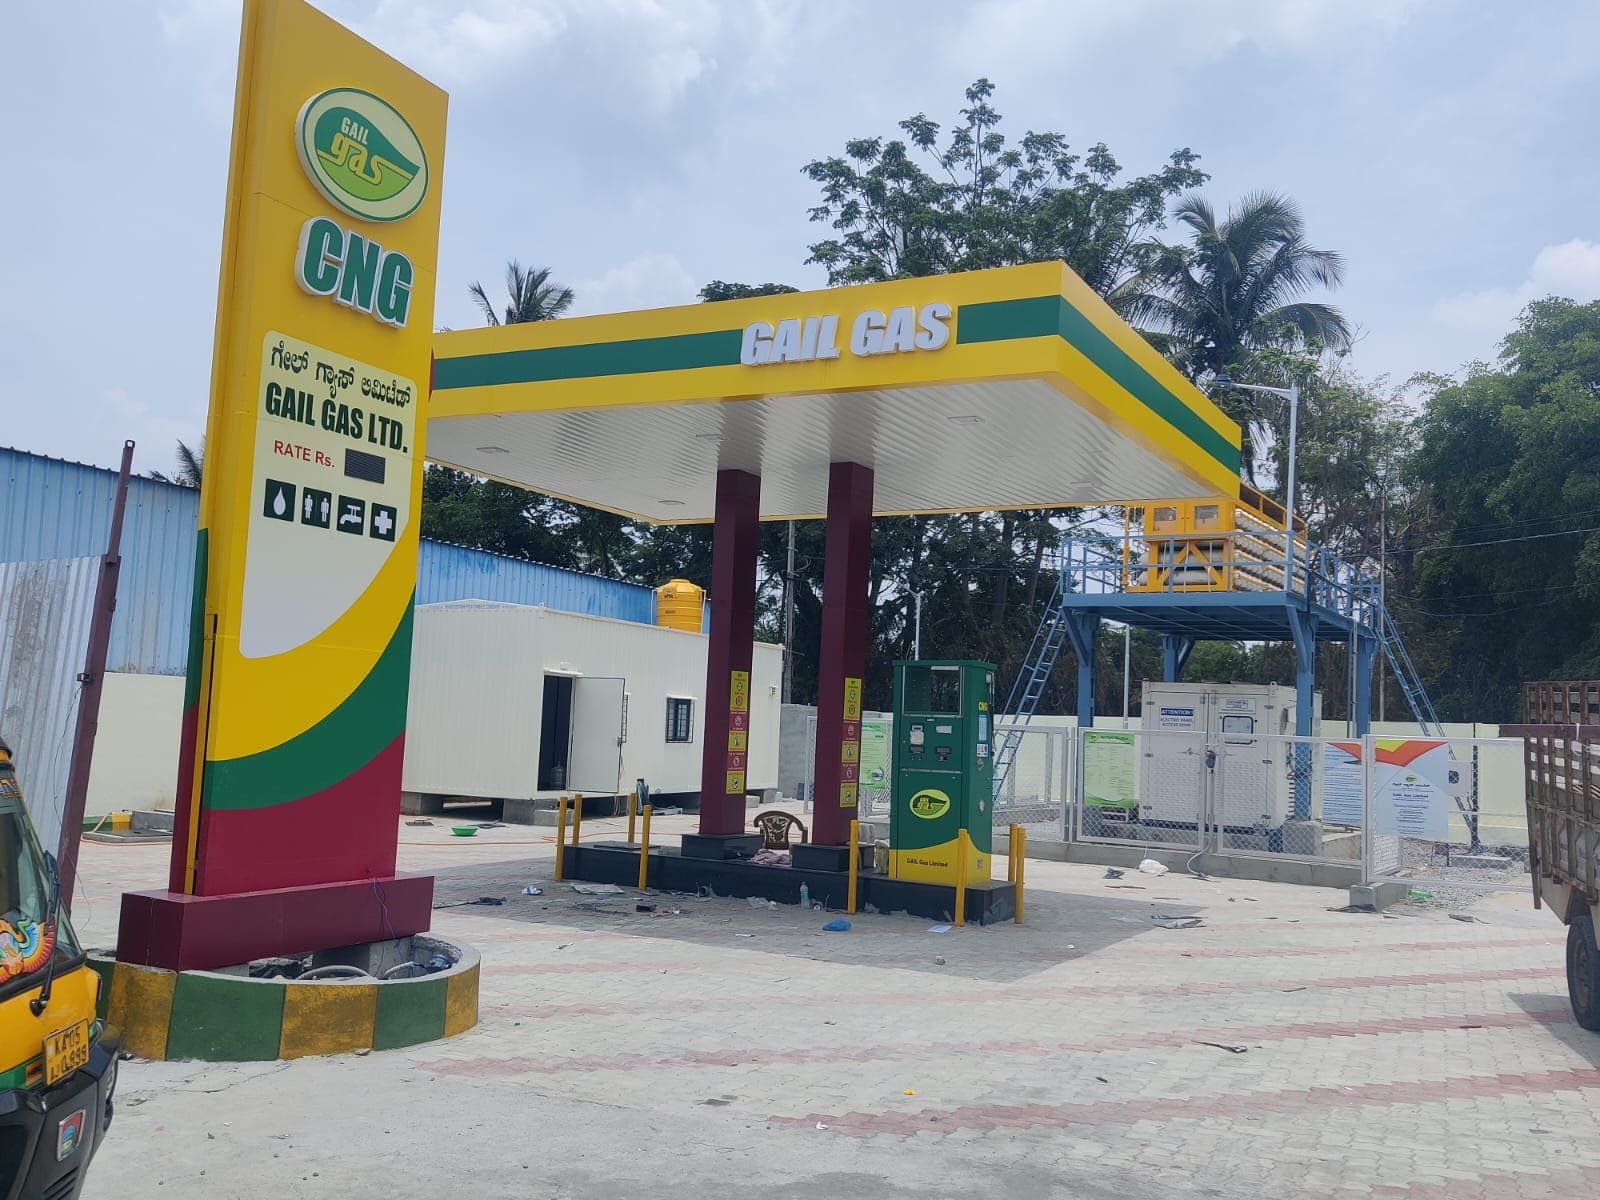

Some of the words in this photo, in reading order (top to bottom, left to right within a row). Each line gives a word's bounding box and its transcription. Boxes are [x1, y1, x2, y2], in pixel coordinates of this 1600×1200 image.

[318, 132, 400, 186] gas
[341, 116, 369, 145] GAIL
[296, 216, 414, 328] CNG
[740, 313, 841, 367] GAIL
[850, 301, 953, 357] GAS
[265, 381, 316, 427] GAIL
[321, 398, 364, 440] GAS
[367, 412, 408, 454] LTD.
[273, 439, 312, 462] RATE
[315, 450, 335, 468] Rs.
